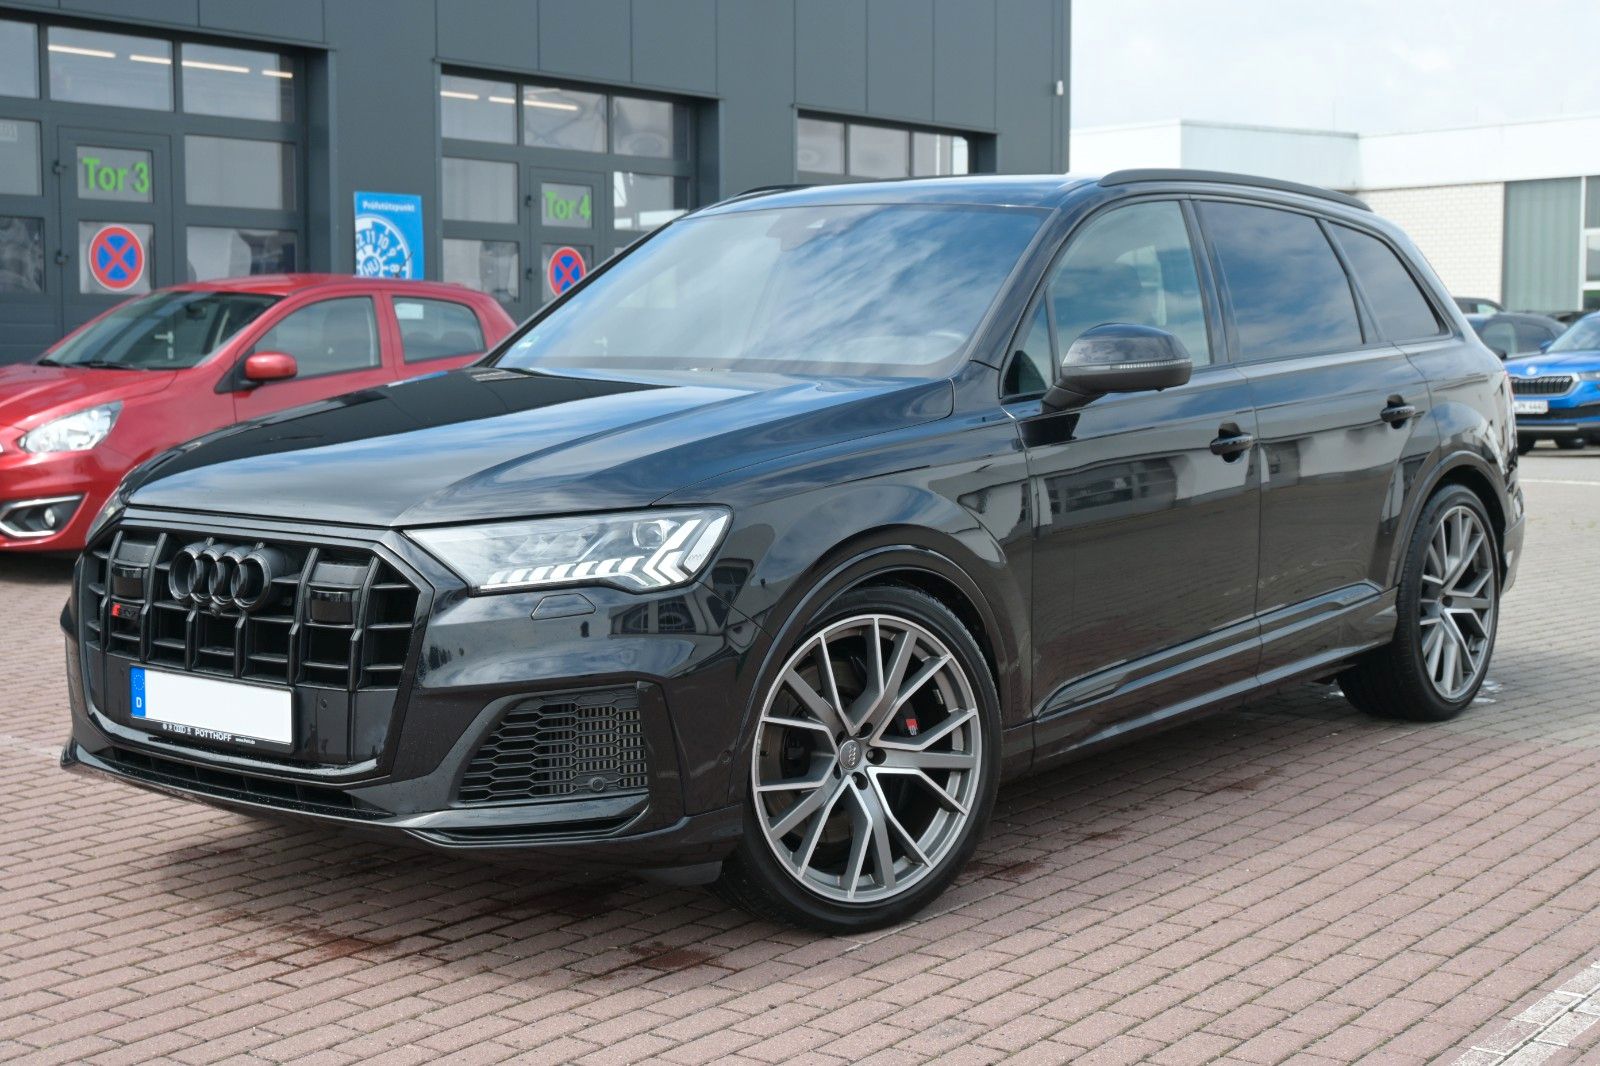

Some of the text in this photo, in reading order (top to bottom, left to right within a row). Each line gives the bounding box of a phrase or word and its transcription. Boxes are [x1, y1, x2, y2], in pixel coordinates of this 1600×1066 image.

[82, 157, 149, 193] Tor 3
[545, 191, 591, 220] Tor 4
[366, 230, 376, 244] 11
[377, 233, 390, 250] 10
[136, 696, 142, 708] D
[194, 727, 232, 742] POTTHOFF
